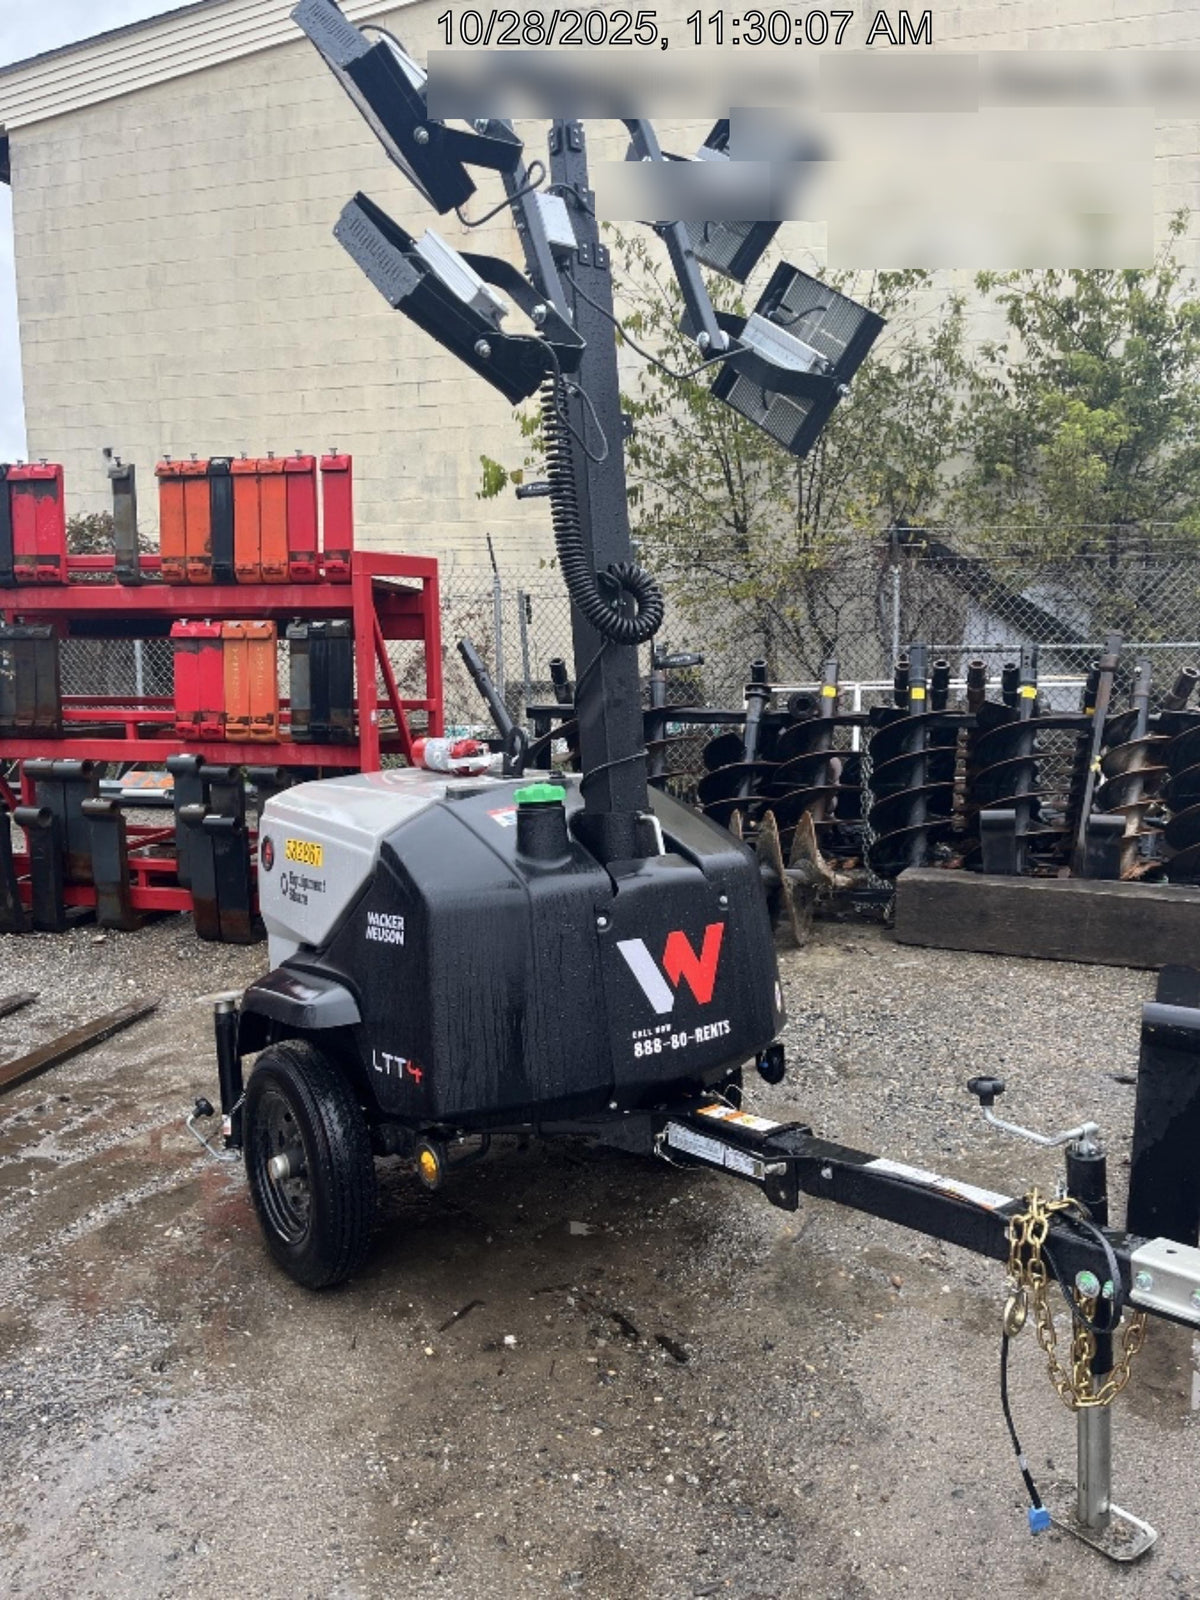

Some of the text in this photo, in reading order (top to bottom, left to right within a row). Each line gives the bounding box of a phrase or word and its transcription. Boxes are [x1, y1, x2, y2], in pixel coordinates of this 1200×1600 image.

[367, 911, 404, 931] WACKER
[365, 925, 404, 947] NEUSON
[632, 1028, 653, 1039] CALL
[634, 1019, 732, 1059] 888-80-RENTS
[372, 1048, 423, 1084] LTT4
